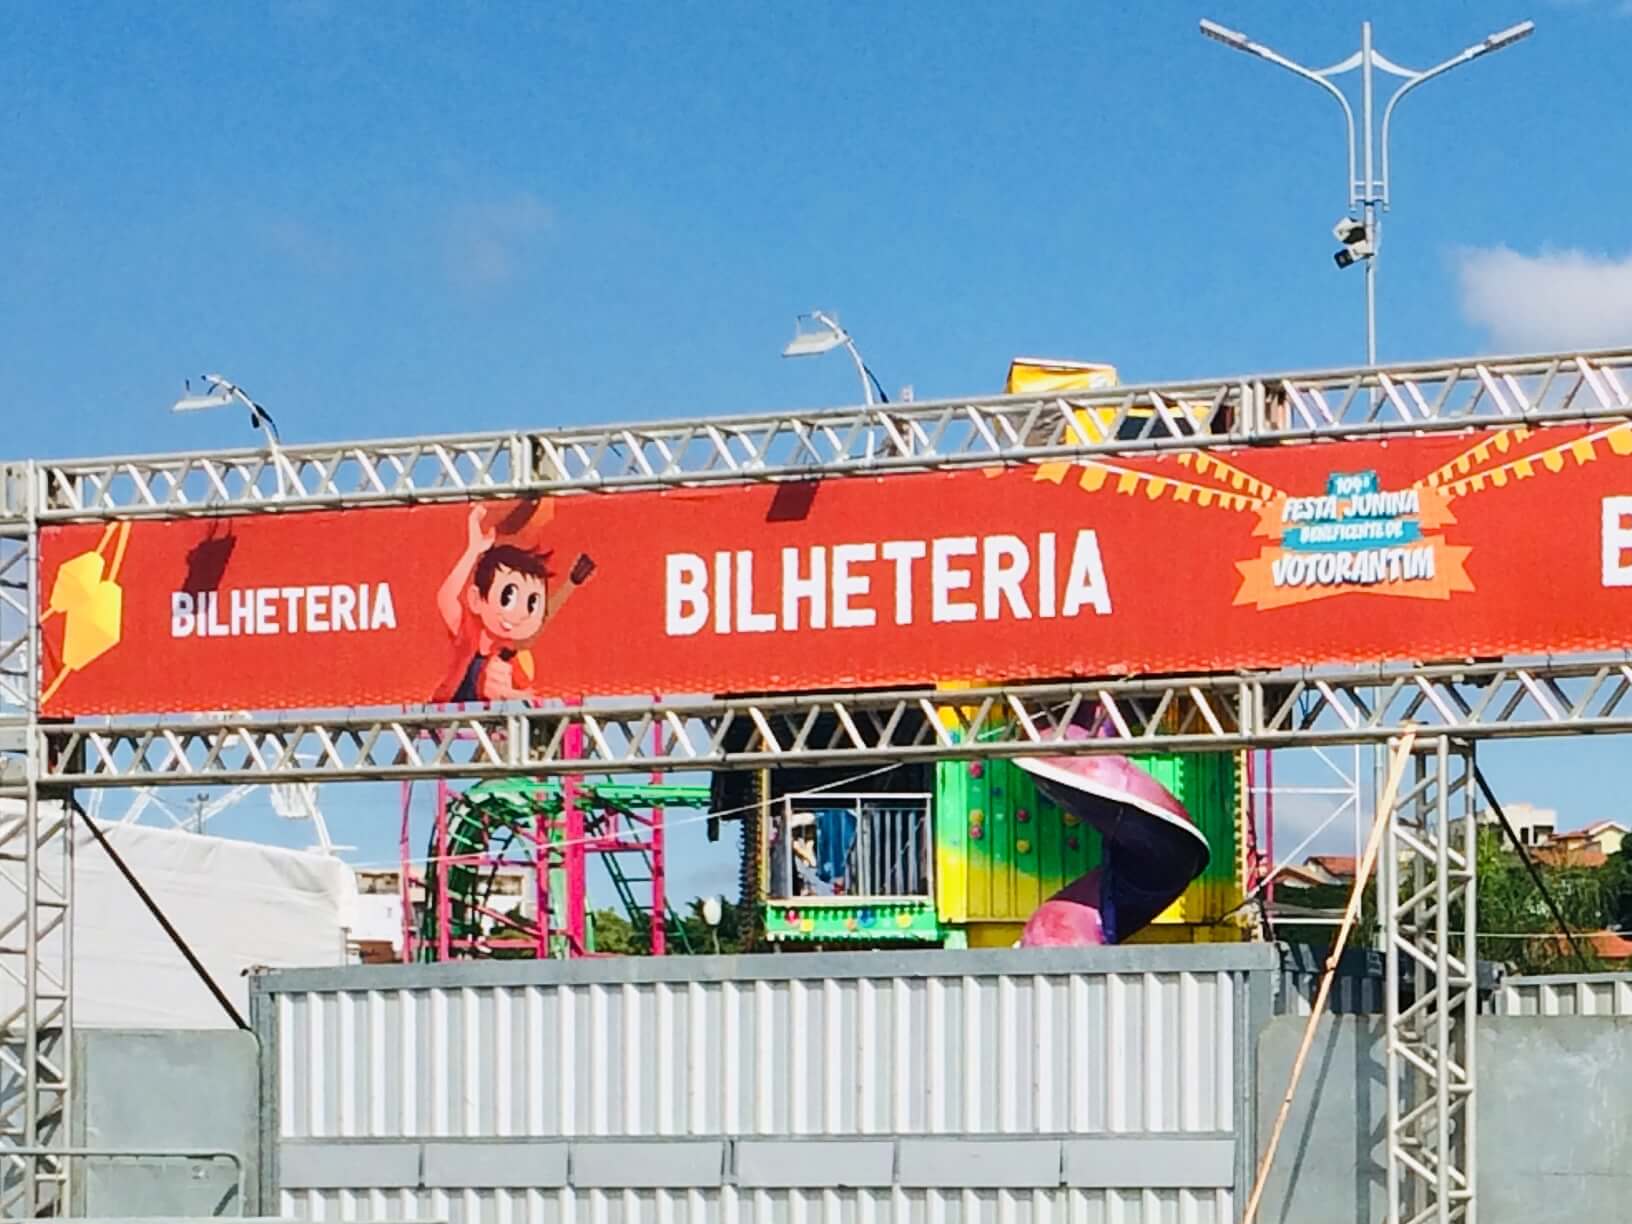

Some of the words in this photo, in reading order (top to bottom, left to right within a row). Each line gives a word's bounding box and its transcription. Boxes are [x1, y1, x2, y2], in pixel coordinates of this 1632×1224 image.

[1281, 496, 1337, 523] FESTA
[1342, 489, 1420, 518] JUNINA
[665, 529, 1113, 636] BILHETERIA
[1271, 546, 1435, 587] VOTORANTIM
[171, 582, 397, 638] BILHETERIA
